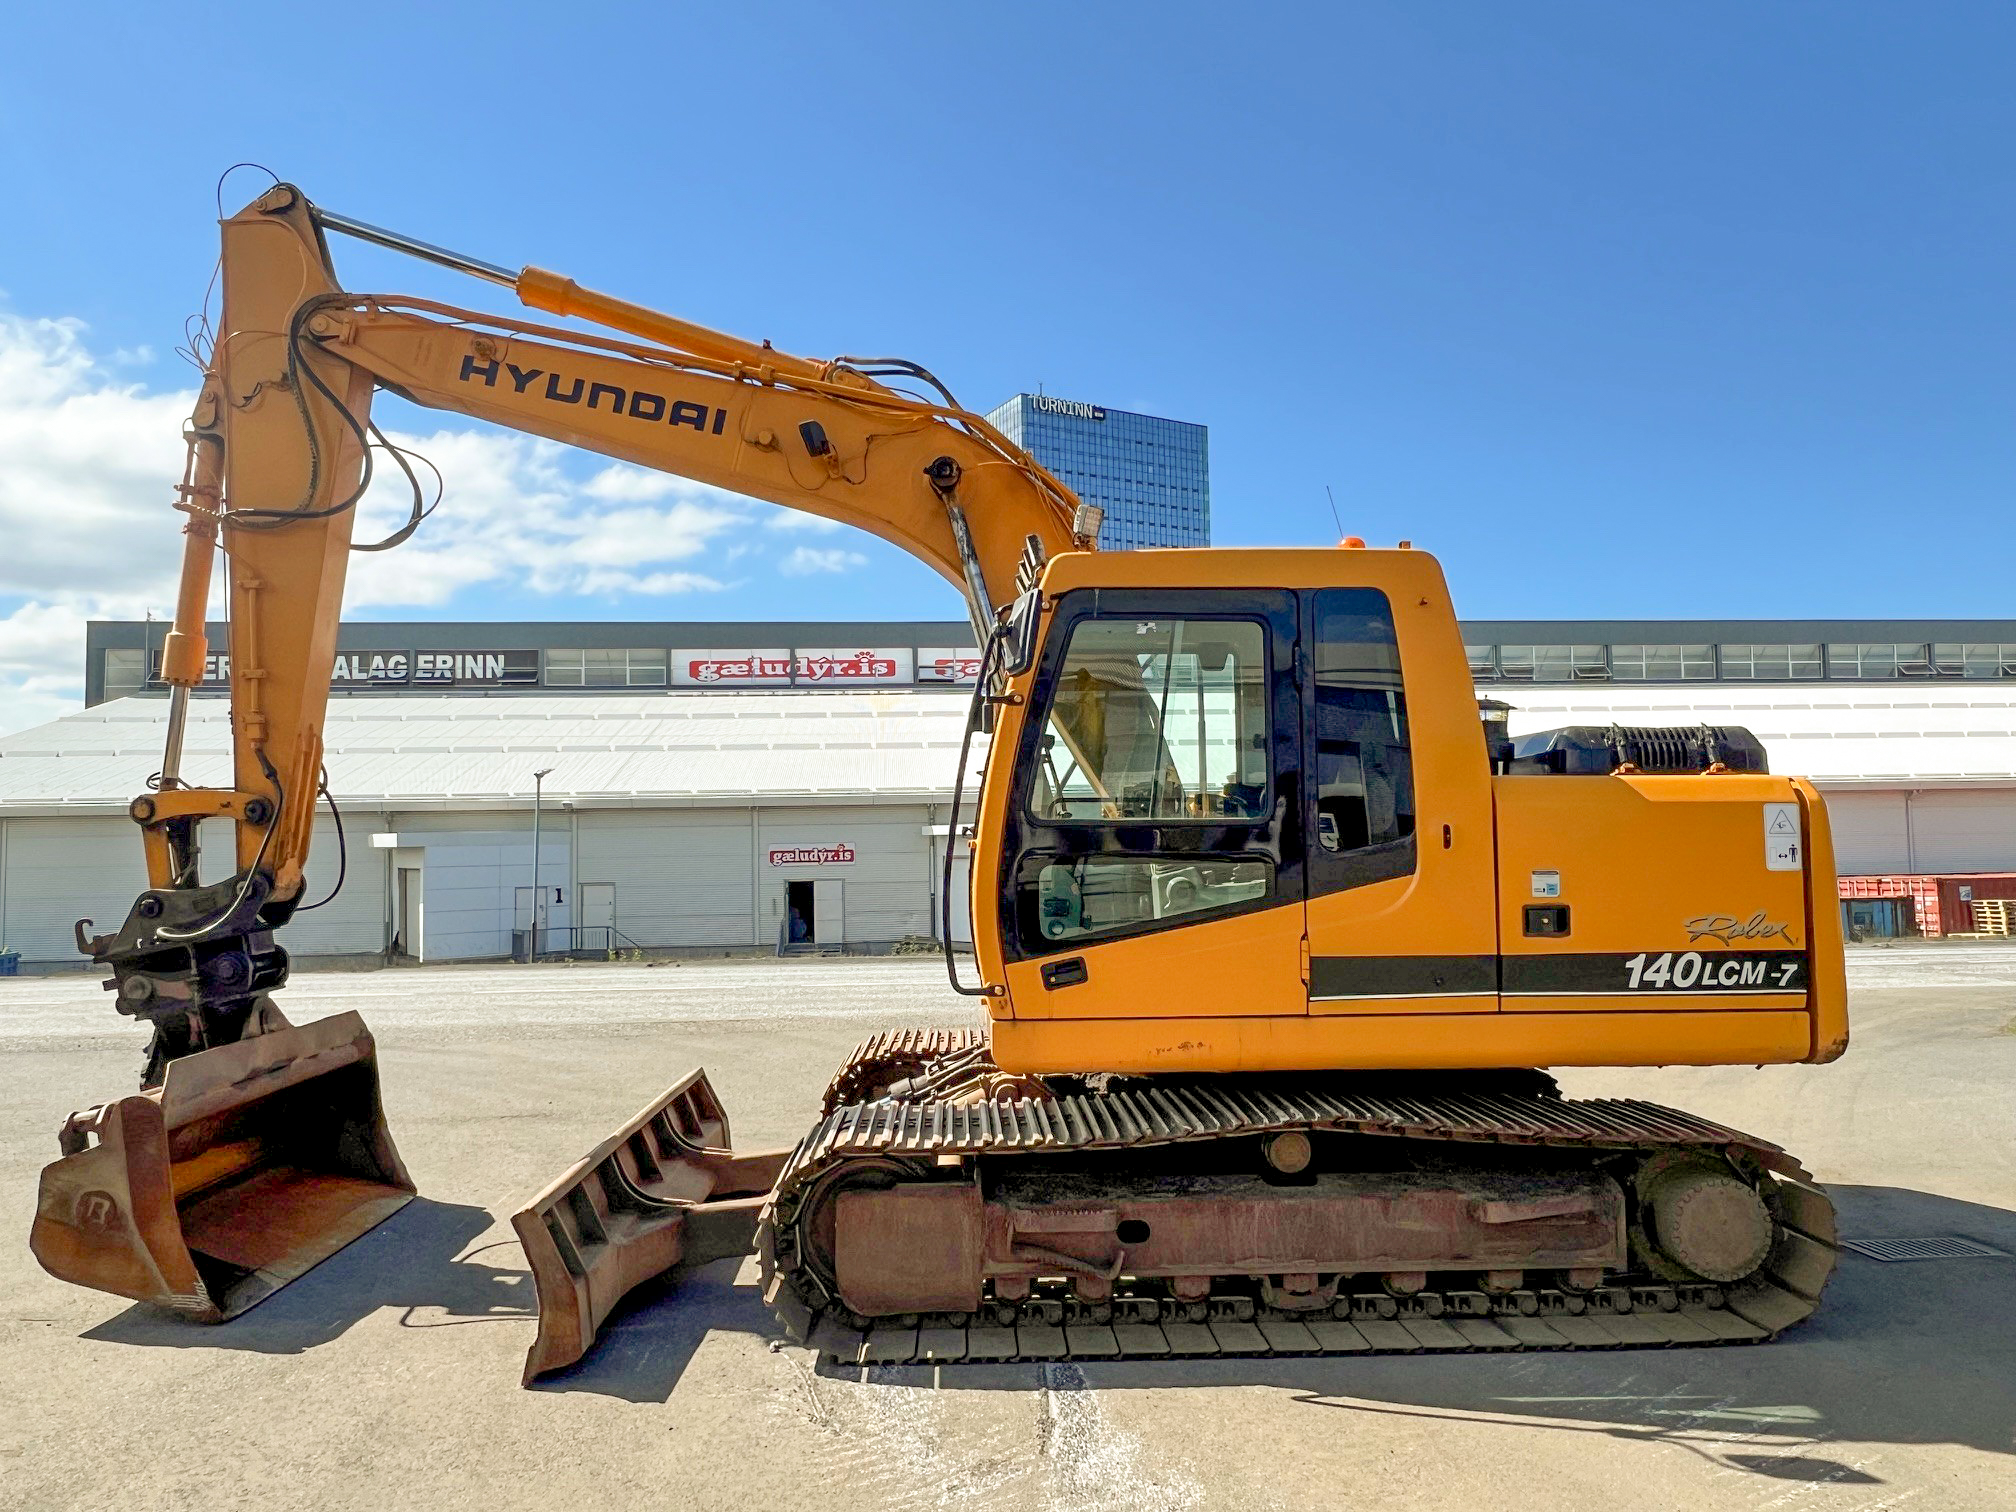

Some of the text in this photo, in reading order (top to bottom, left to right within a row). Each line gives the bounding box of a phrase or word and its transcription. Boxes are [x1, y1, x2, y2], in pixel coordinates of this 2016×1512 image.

[459, 354, 728, 435] HYUNDAI
[697, 656, 889, 682] gæludýr.is
[772, 847, 852, 866] gæludýr.is
[555, 887, 563, 903] 1
